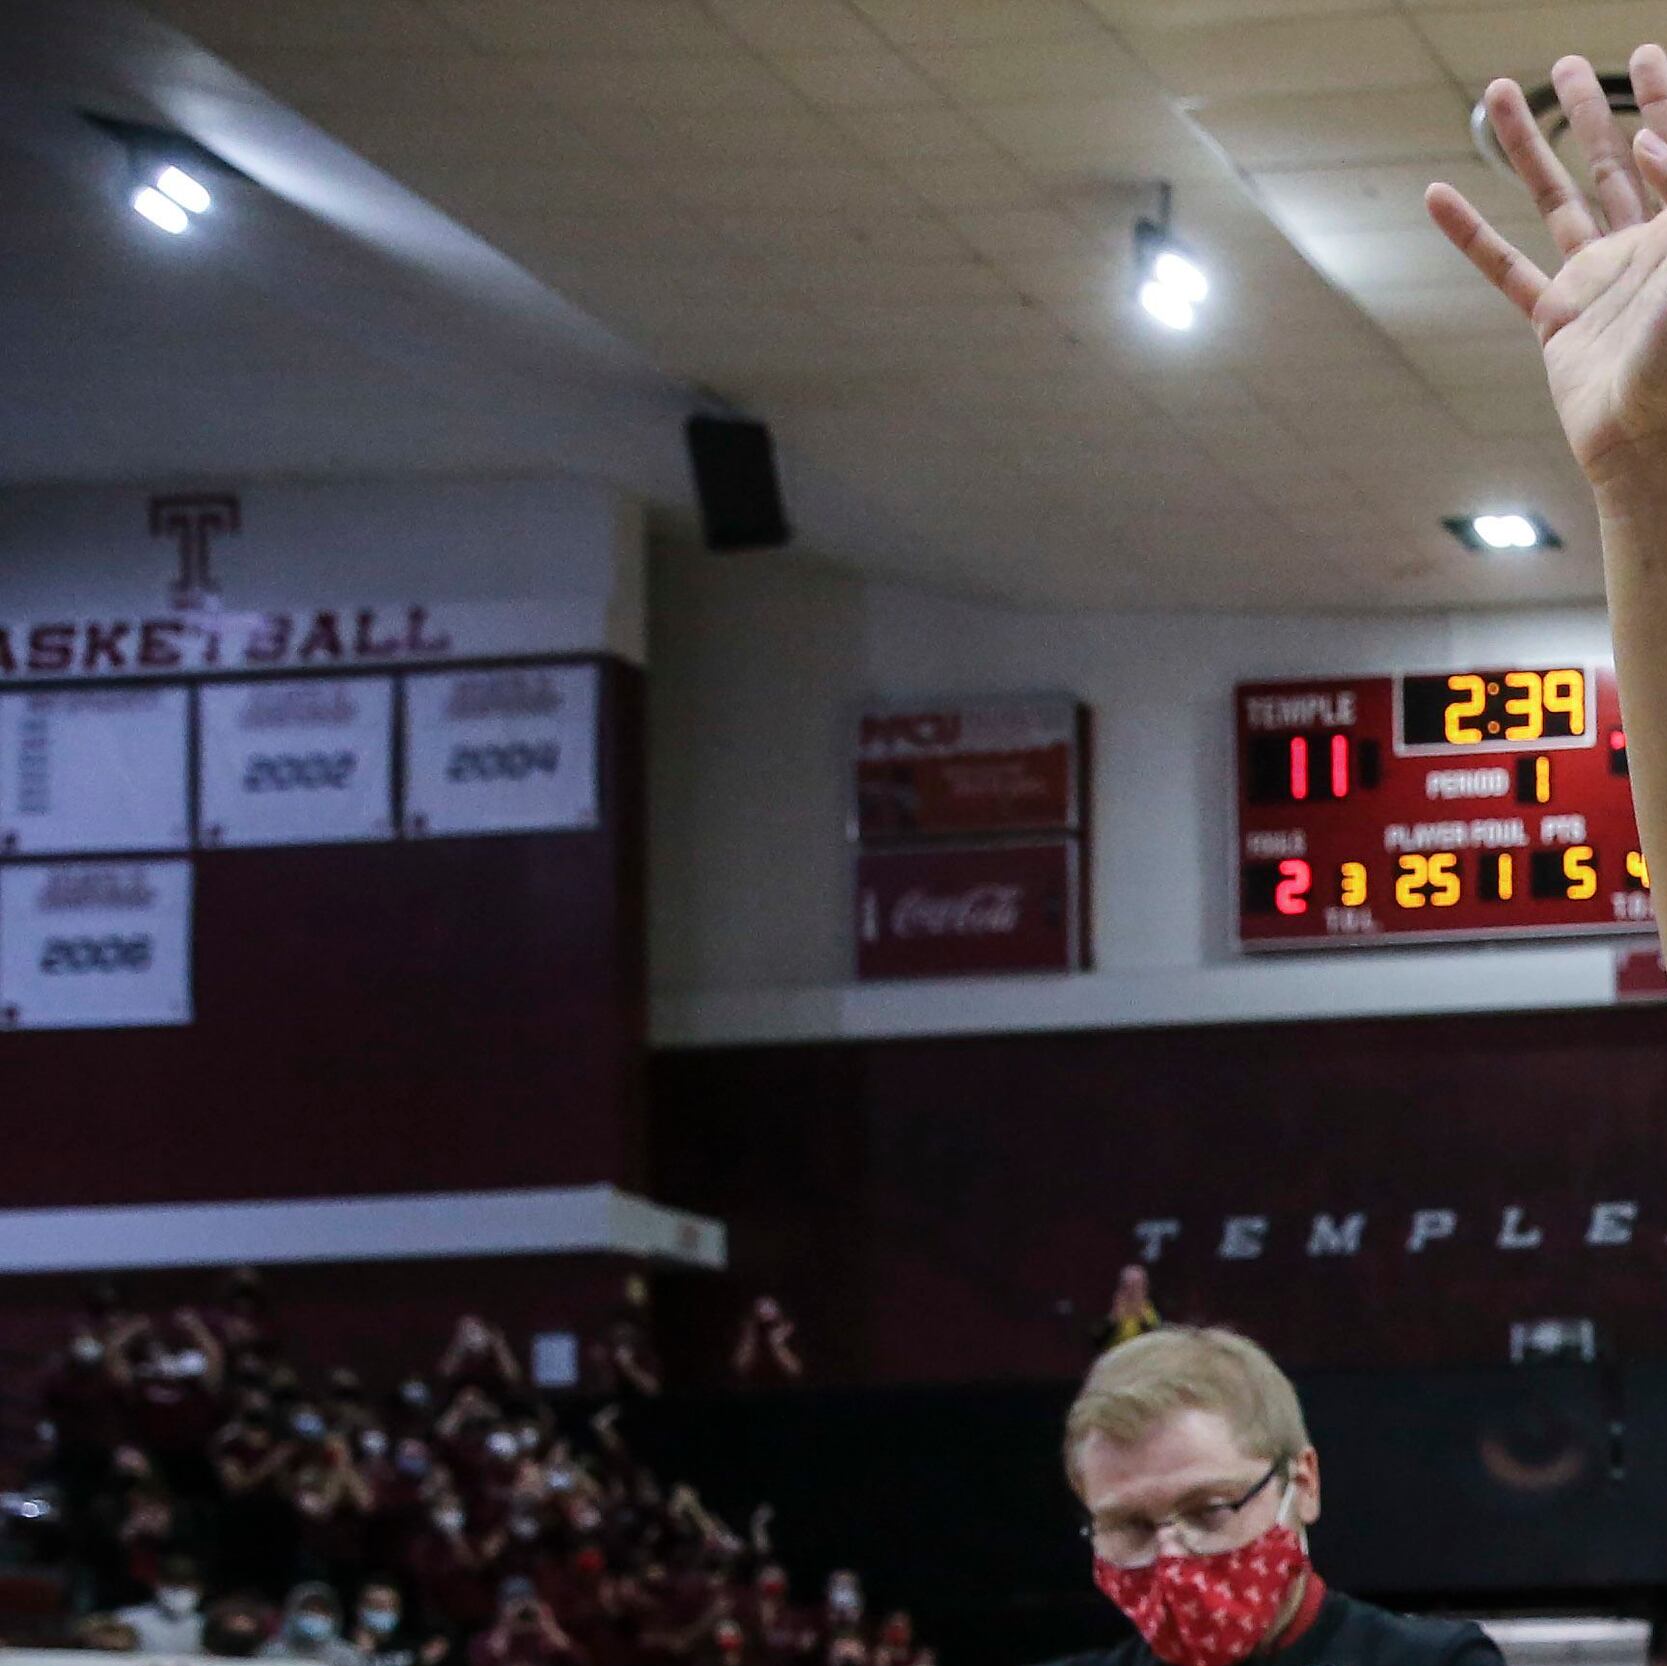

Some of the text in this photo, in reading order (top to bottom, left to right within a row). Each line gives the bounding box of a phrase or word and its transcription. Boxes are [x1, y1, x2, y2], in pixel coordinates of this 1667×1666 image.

[1246, 690, 1357, 728] TEMPLE
[1444, 669, 1585, 745] 2:39
[1290, 734, 1350, 799] 11
[1426, 756, 1550, 803] PERIOD 1
[1384, 814, 1587, 853] PLAYER FOUL PTS
[1275, 858, 1312, 915] 2
[1341, 862, 1368, 907] 3
[1395, 852, 1461, 908] 25
[1497, 853, 1513, 900] 1
[1563, 846, 1597, 900] 5
[1134, 1202, 1639, 1262] TEMPLE
